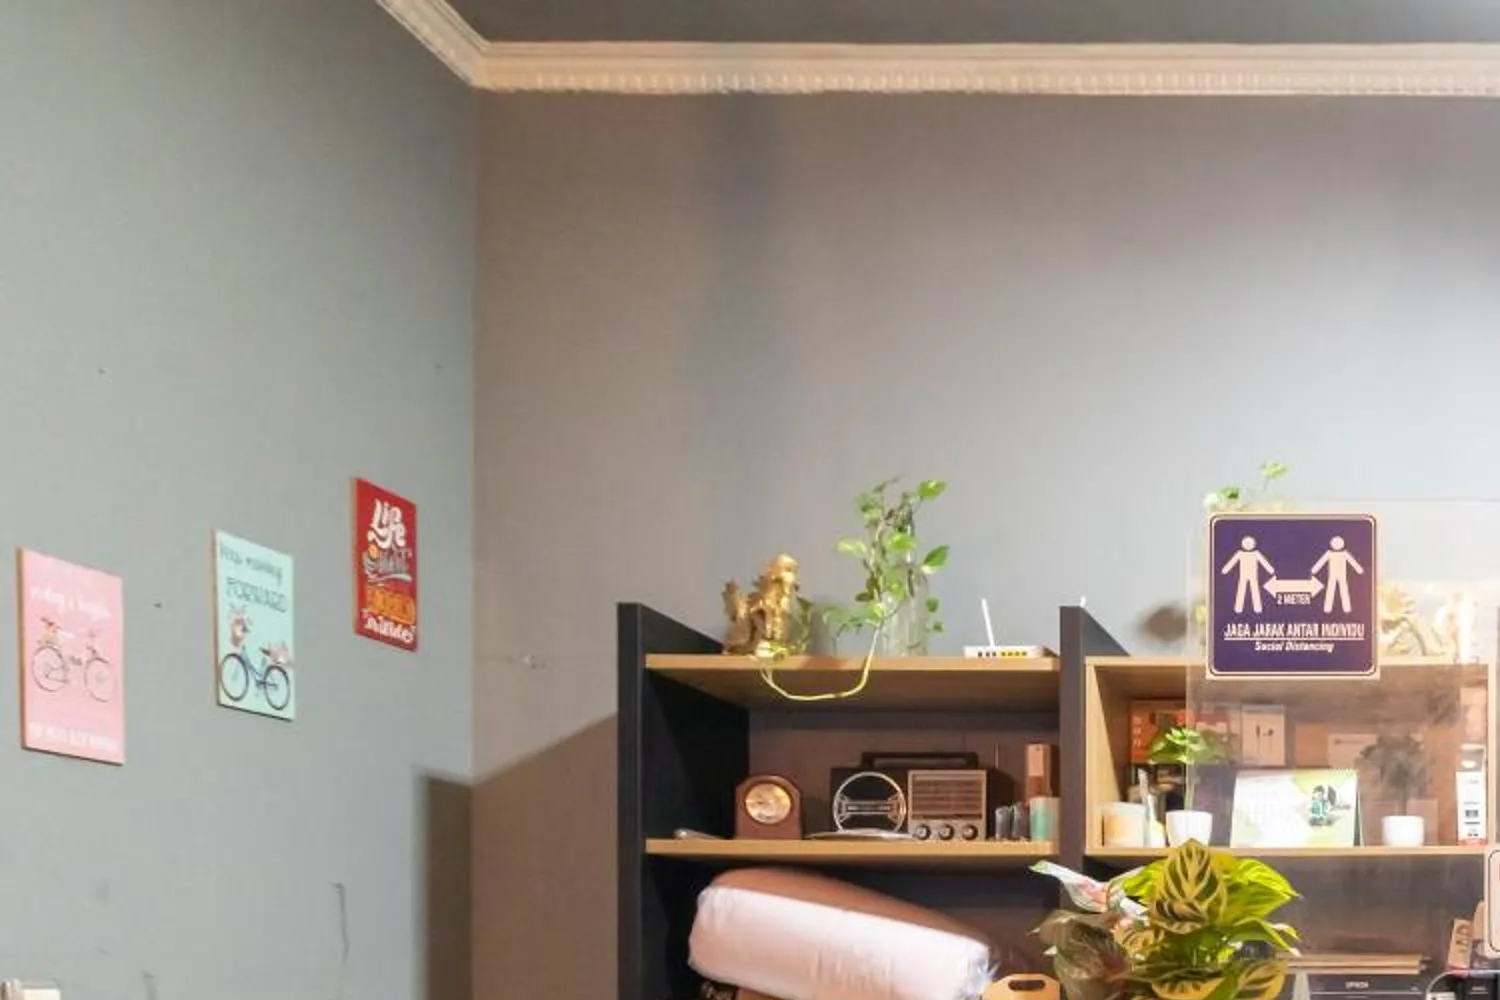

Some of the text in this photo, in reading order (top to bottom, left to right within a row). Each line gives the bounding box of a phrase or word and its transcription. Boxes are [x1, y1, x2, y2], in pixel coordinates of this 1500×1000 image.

[1276, 593, 1311, 605] 2 METER
[1224, 623, 1365, 638] JAGA JARAK ANTAR INDIVIDU
[1254, 641, 1335, 653] Social Distancing
